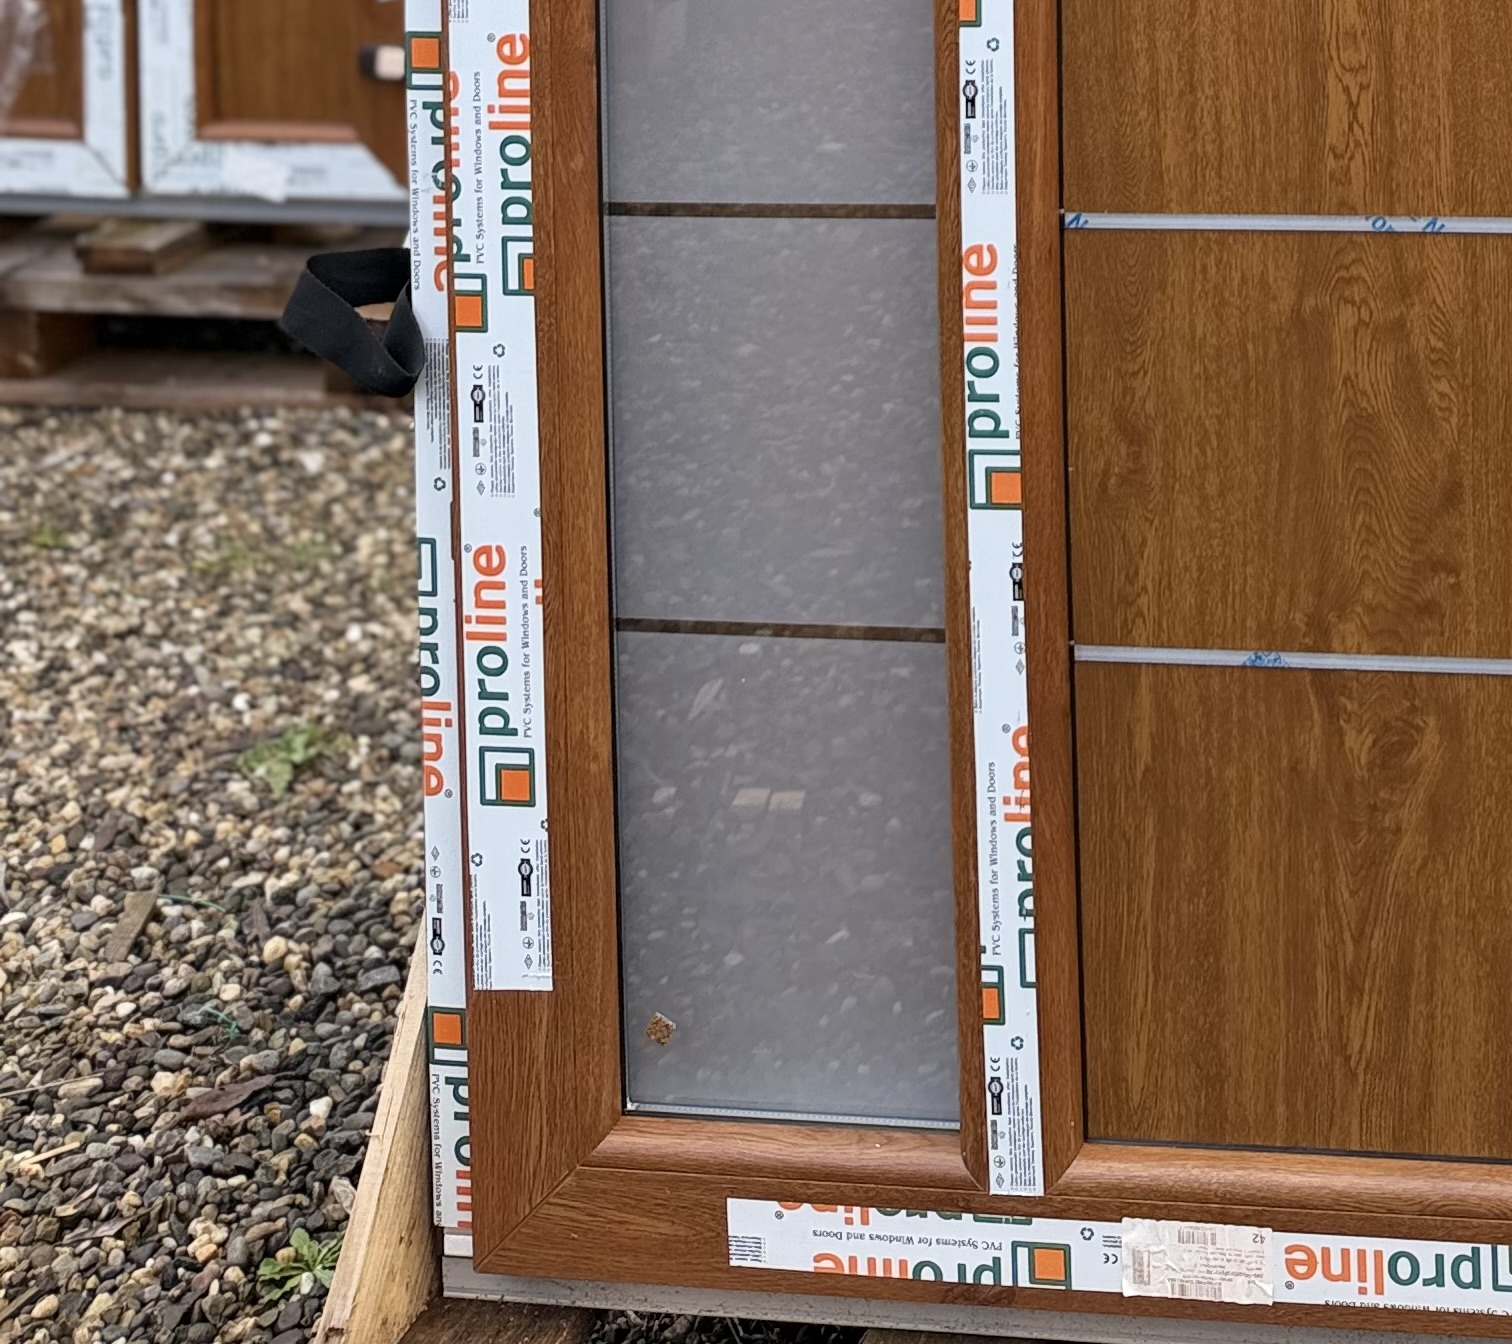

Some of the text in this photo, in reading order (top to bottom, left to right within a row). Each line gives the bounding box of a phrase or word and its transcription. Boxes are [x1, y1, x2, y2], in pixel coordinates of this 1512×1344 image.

[409, 99, 422, 291] PVC Systems for Windows and Doors
[472, 71, 486, 264] PVC Systems for Windows and Doors
[487, 32, 534, 226] proline
[963, 243, 1010, 439] proline
[465, 544, 518, 737] proline
[518, 545, 534, 738] PVC Systems for Windows and Doors
[986, 761, 1002, 956] PVC Systems for Windows and Doors
[811, 1229, 1003, 1251] PVC Systems for Windows and Doors
[1284, 1243, 1482, 1296] proline
